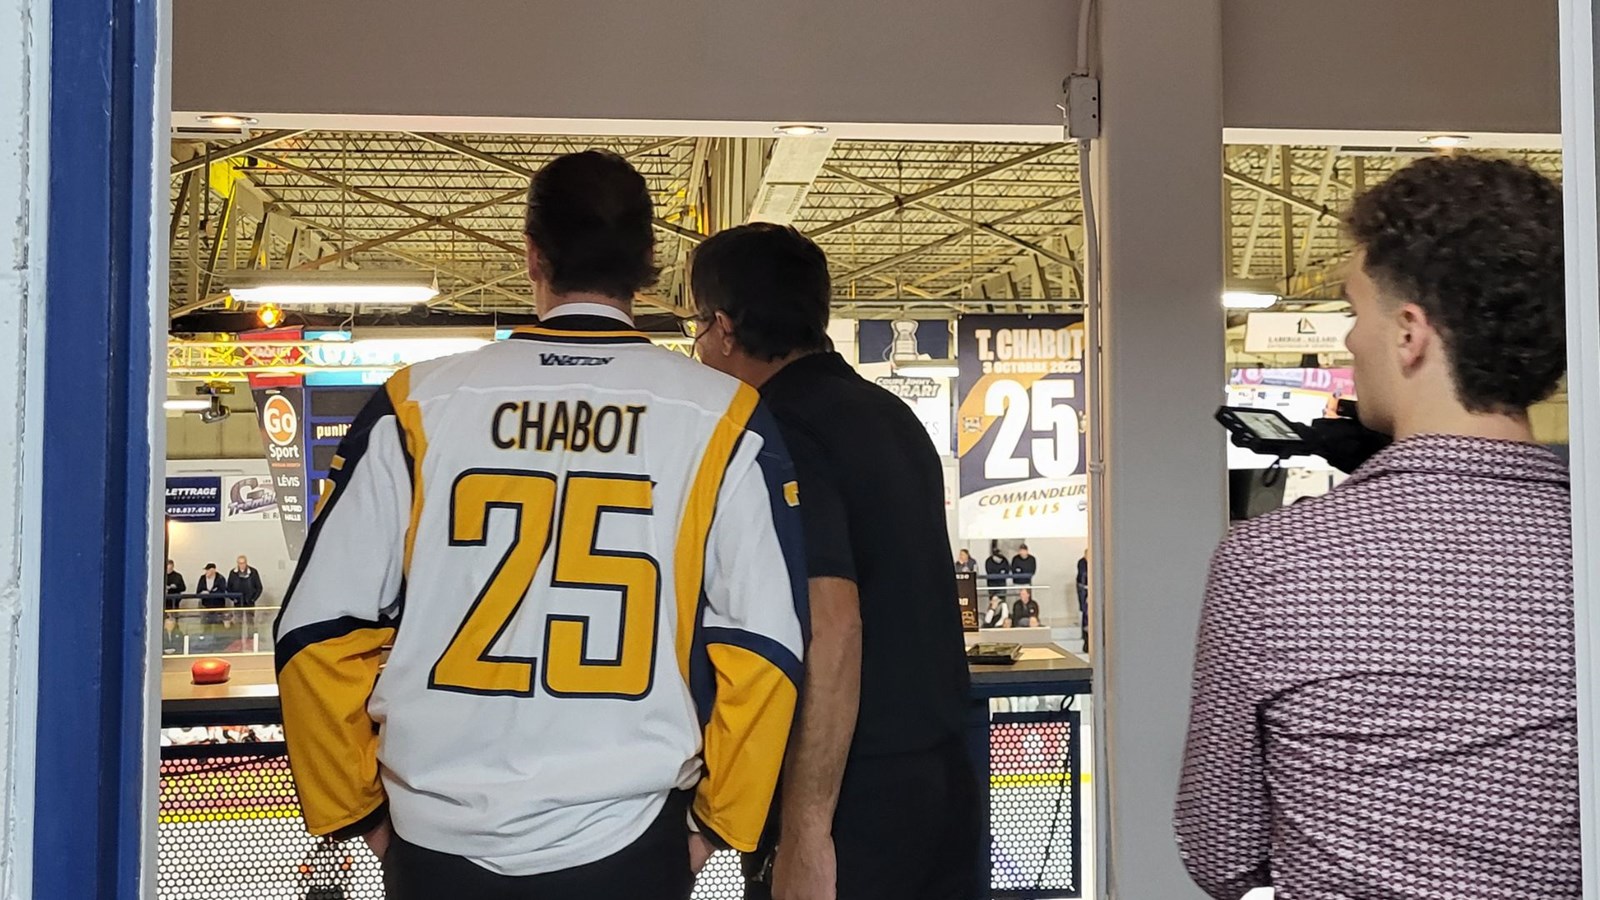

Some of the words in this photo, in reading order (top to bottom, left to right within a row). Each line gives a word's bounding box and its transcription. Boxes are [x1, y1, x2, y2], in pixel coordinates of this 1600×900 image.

[975, 329, 994, 360] T.
[996, 328, 1083, 360] CHABOT
[982, 361, 993, 374] 3
[264, 407, 295, 433] Go
[490, 400, 646, 454] CHABOT
[985, 379, 1080, 479] 25
[269, 443, 299, 461] Sport
[166, 487, 217, 496] LETTRAGE
[277, 475, 300, 487] LÉVIS
[978, 484, 1086, 507] COMMANDEUR
[1003, 502, 1060, 519] LÉVIS
[428, 467, 661, 701] 25
